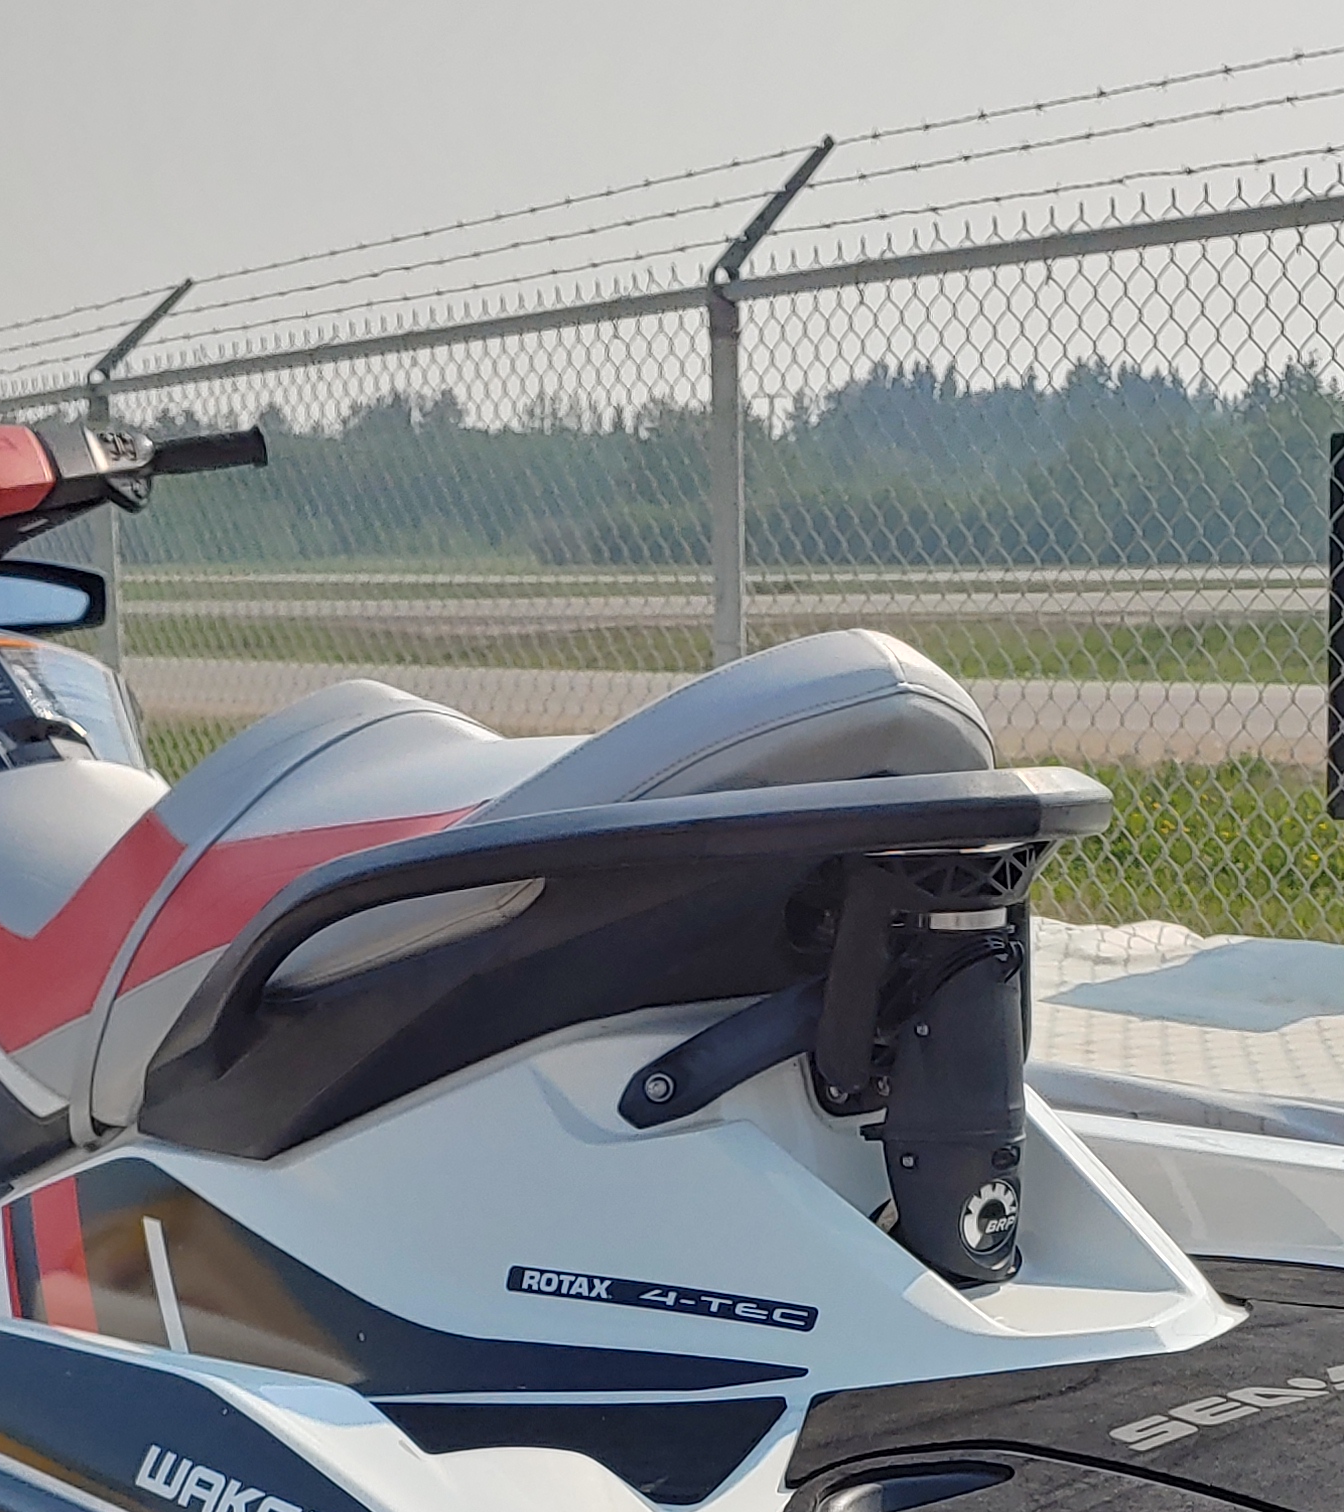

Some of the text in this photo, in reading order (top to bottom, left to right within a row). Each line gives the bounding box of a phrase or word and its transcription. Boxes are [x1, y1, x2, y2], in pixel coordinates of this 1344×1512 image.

[984, 1215, 1016, 1234] BRP
[521, 1269, 809, 1326] ROTAX 4-TEC
